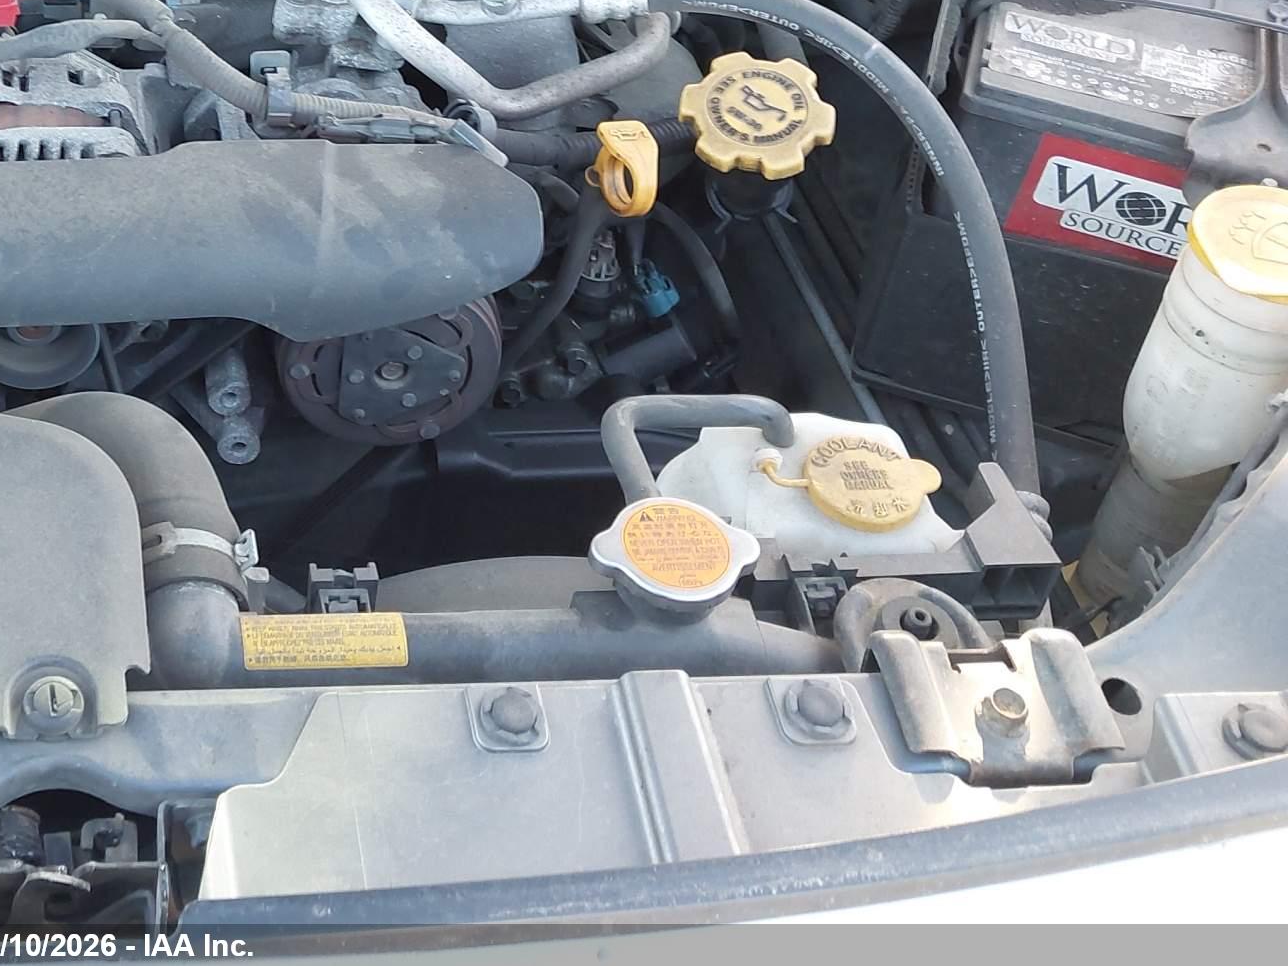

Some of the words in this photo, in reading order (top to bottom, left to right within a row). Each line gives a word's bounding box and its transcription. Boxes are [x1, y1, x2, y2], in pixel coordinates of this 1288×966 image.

[714, 75, 737, 94] SEE
[754, 119, 803, 143] MANUAL
[742, 70, 794, 91] ENGINE
[791, 93, 806, 111] OIL
[811, 436, 902, 468] COOLANT
